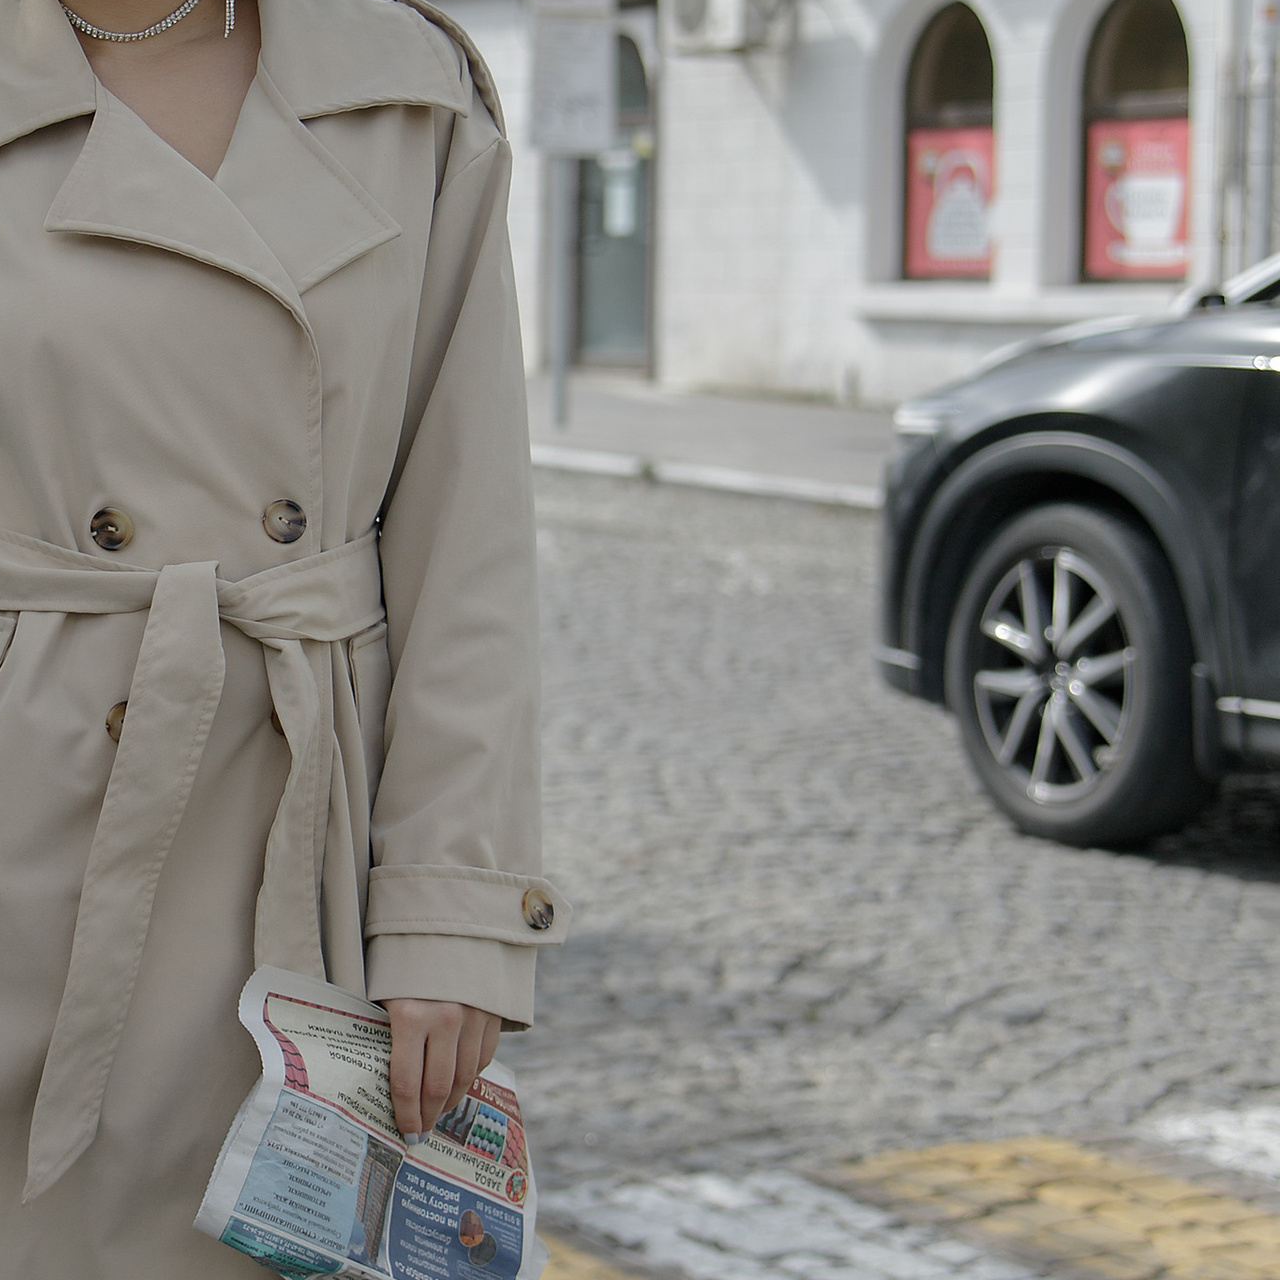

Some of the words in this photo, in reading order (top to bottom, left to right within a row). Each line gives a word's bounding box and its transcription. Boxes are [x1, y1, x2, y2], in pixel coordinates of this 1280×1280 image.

[306, 1022, 344, 1038] пленки
[345, 1031, 392, 1048] овельные
[351, 1020, 394, 1041] плитель
[325, 1039, 372, 1061] системы
[327, 1047, 373, 1074] стеновой
[372, 1054, 391, 1067] ные
[372, 1082, 392, 1100] астил
[334, 1090, 370, 1118] материалы
[422, 1136, 453, 1157] МАТЕРИ
[451, 1148, 506, 1180] КРОВЕЛЬНЫХ
[286, 1172, 332, 1197] АРМАТУРЩИКИ,
[402, 1170, 420, 1185] цех.
[418, 1179, 426, 1187] в
[471, 1170, 502, 1192] ЗАВОД
[286, 1184, 327, 1208] БЕТОНЩИКИ,
[395, 1180, 428, 1203] требуются
[424, 1181, 461, 1202] рабочие
[251, 1194, 282, 1213] требуются
[287, 1198, 331, 1222] МОНТАЖНИКИ
[398, 1197, 447, 1223] постоянную
[427, 1196, 460, 1216] работу
[402, 1217, 452, 1245] благоустройства
[445, 1217, 458, 1228] на
